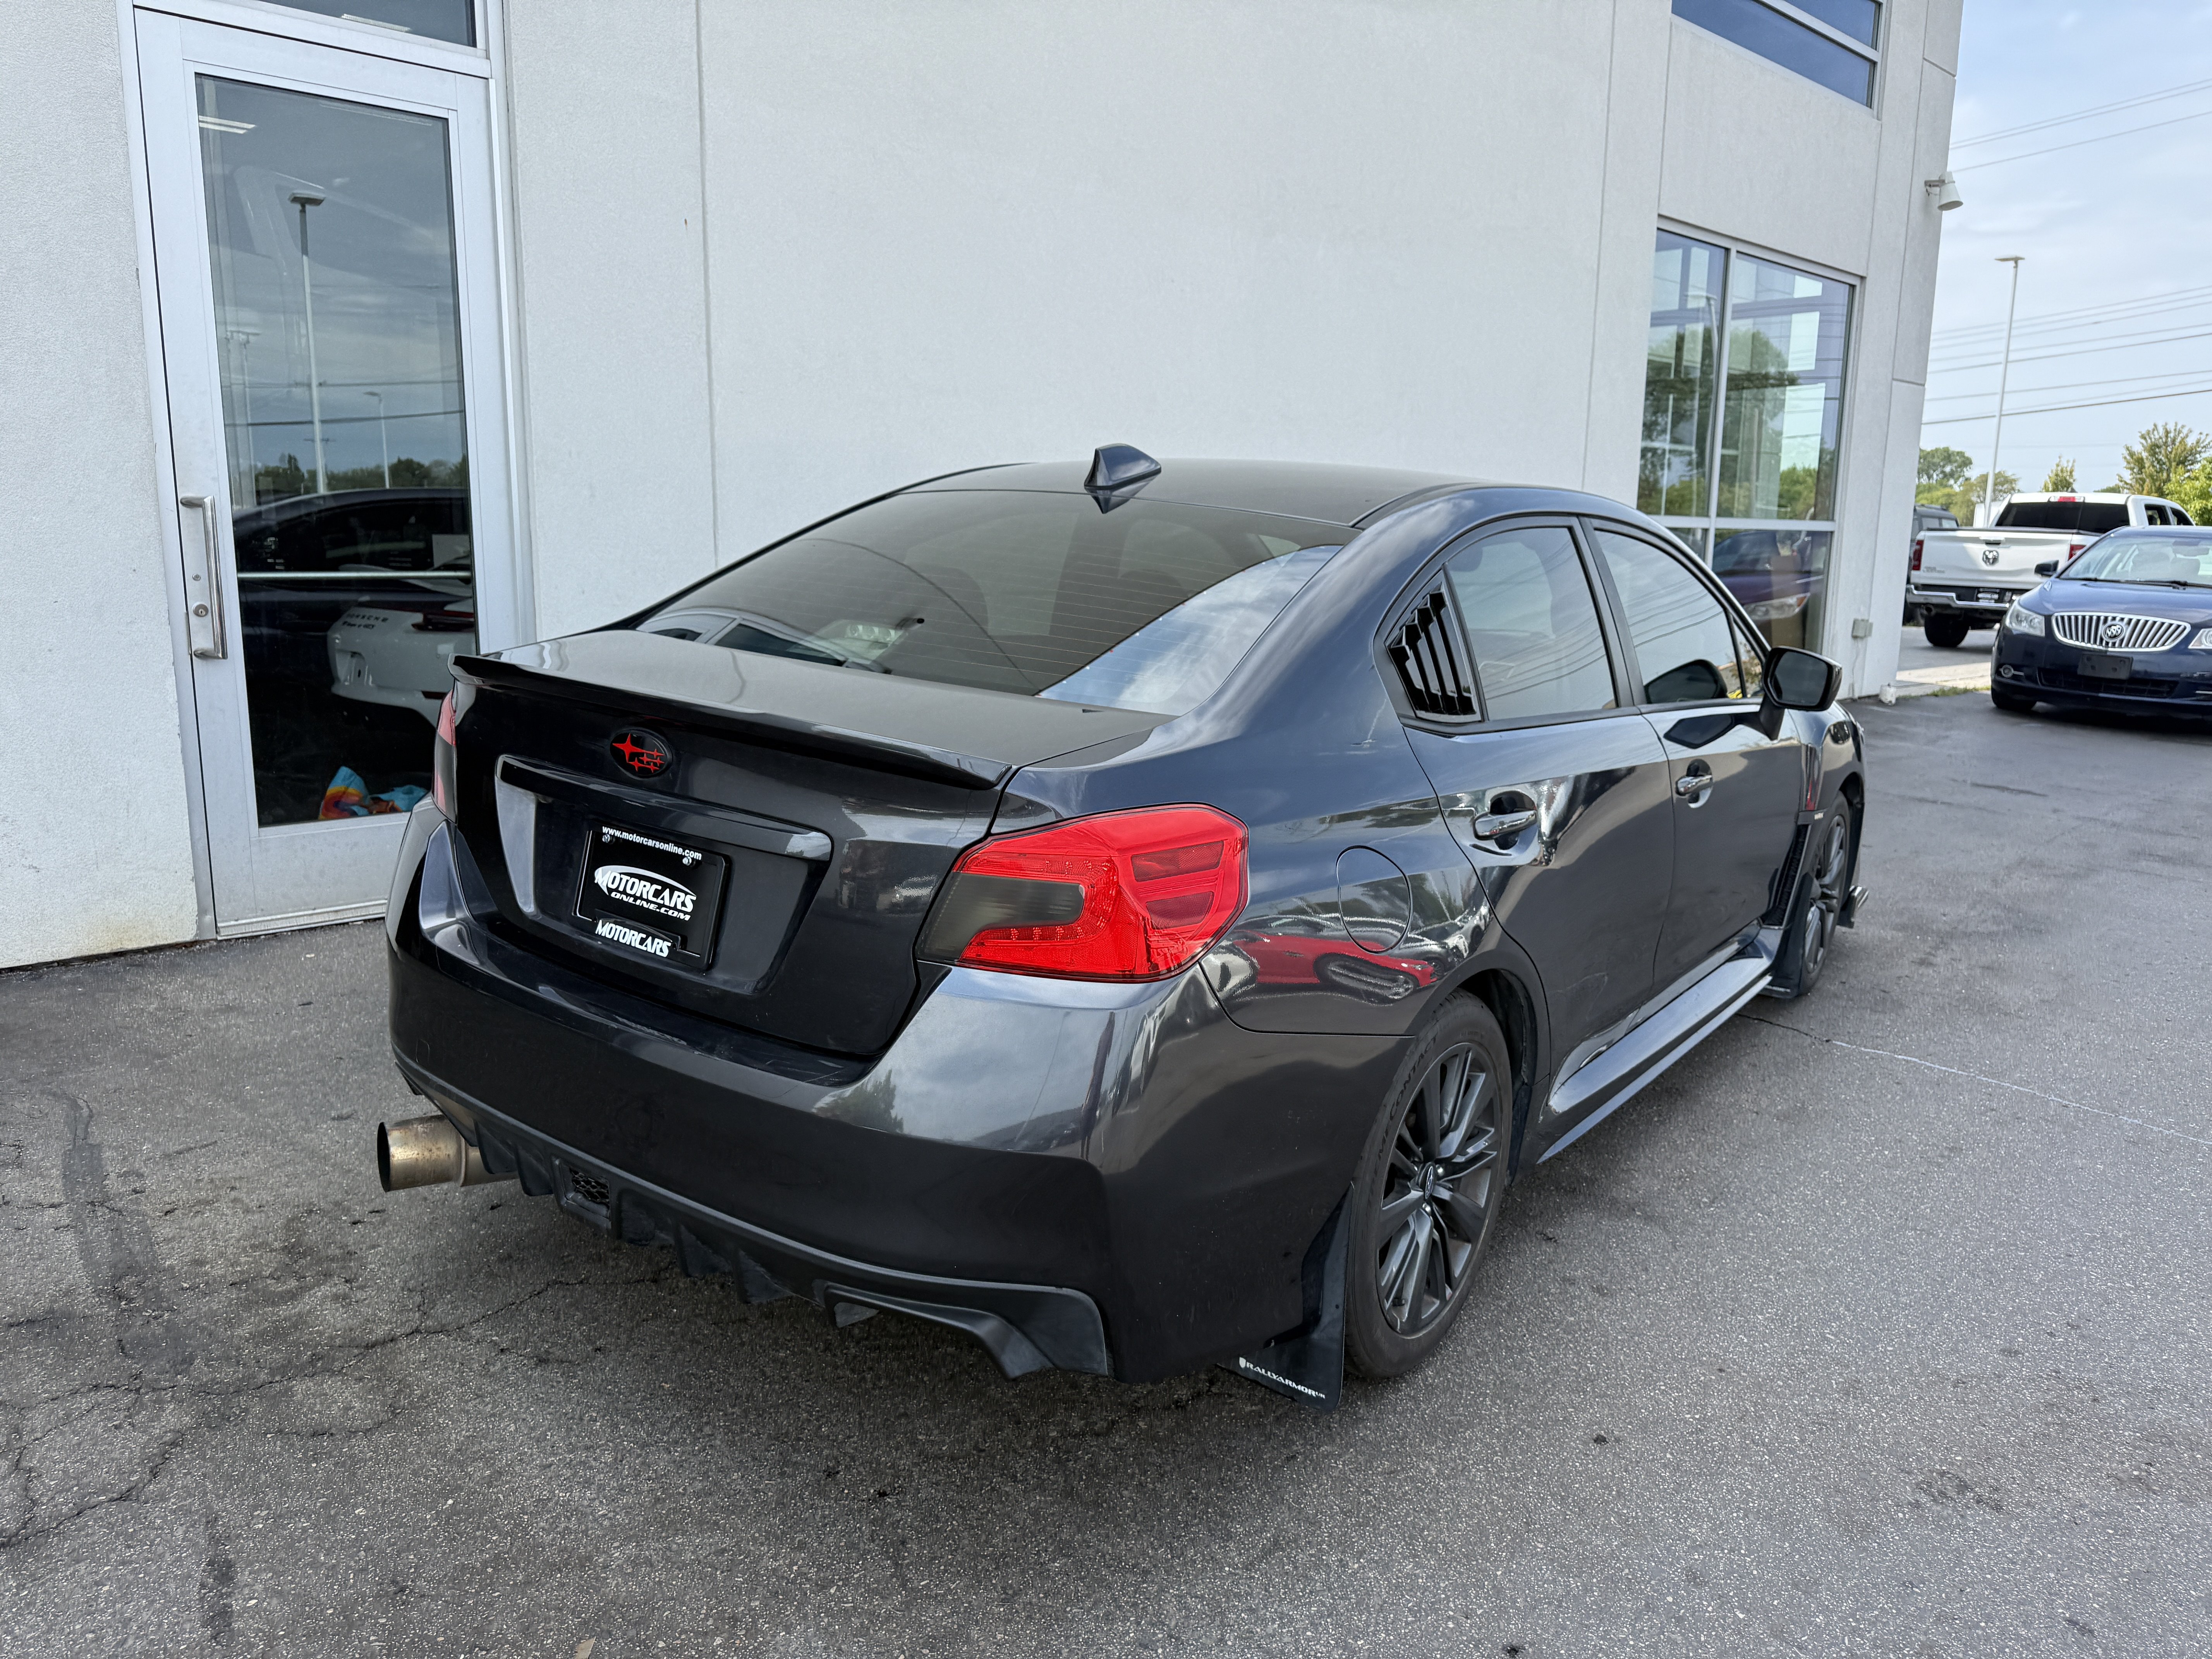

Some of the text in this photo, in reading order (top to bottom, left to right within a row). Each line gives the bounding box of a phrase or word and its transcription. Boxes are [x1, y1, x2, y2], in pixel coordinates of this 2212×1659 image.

[602, 826, 702, 860] www.motorcarsonline.com
[594, 868, 697, 912] MOTORCARS
[611, 891, 691, 921] ONLINE.COM
[595, 919, 672, 958] MOTORCARS
